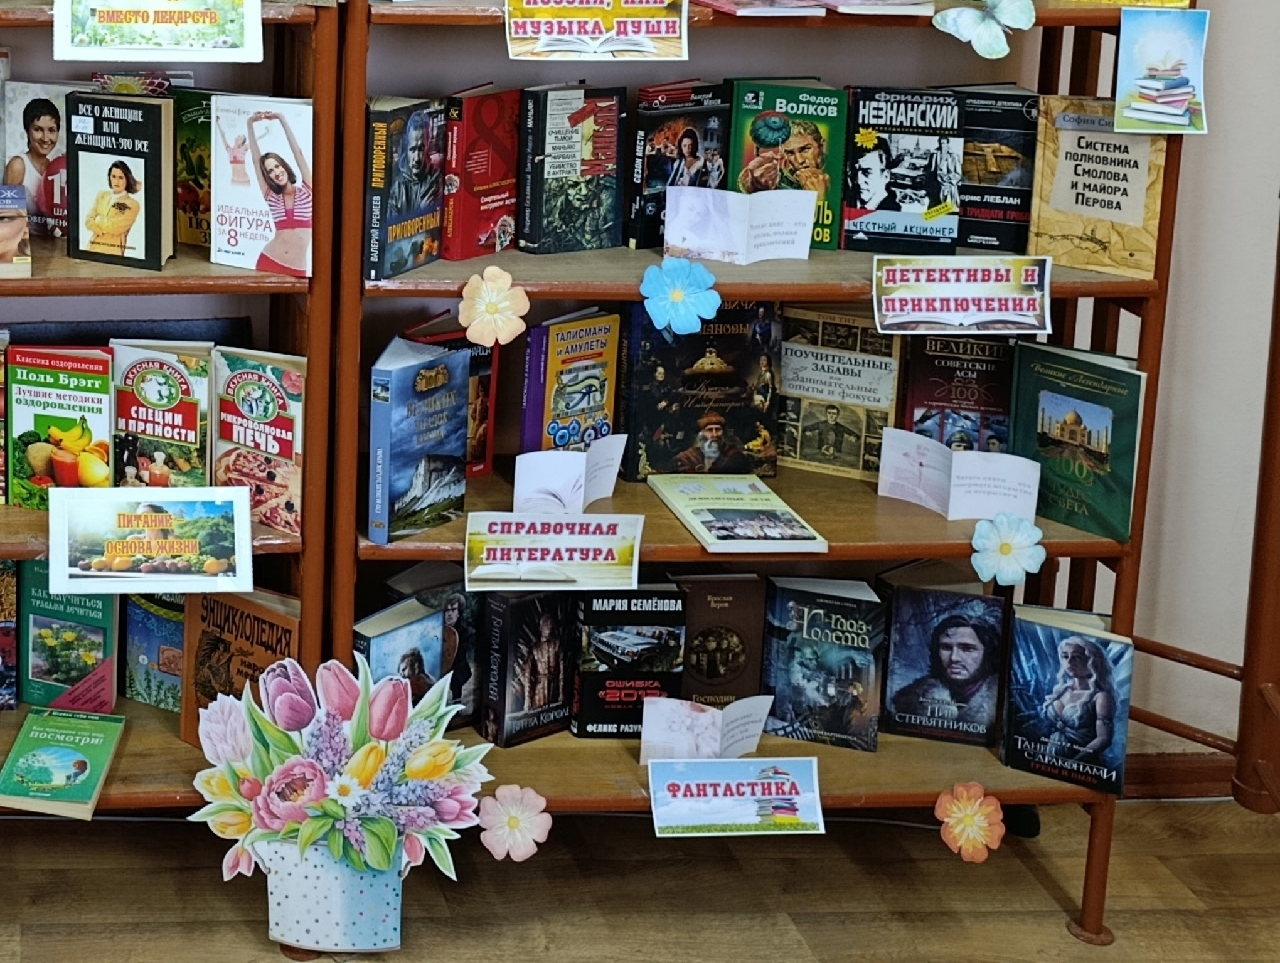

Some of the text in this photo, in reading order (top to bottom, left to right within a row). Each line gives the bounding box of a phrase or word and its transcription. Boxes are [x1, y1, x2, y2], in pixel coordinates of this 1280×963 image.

[97, 10, 218, 26] ВМЕСТО ЛЕКАРСТВ
[511, 19, 679, 38] МУЗЫКА ДУШИ
[798, 92, 839, 105] Федор
[775, 98, 838, 117] Волков
[858, 100, 959, 129] НЕЗНАНСКИЙ
[102, 121, 120, 134] ИЛИ
[1062, 114, 1093, 125] София
[635, 130, 645, 158] МЕСТИ
[1064, 151, 1140, 170] ПОЛКОВНИКА
[982, 195, 1021, 206] ЛЕБЛАН
[217, 204, 270, 218] ИДЕАЛЬНАЯ
[216, 216, 272, 233] ФИГУРА
[370, 195, 381, 264] ВАЛЕРИЙ ЕРЕМЕЕВ
[851, 220, 955, 237] ЧЕСТНЫЙ АКЦИОНЕР
[227, 228, 270, 248] 8 НЕДЕЛЬ
[884, 267, 1038, 284] ДЕТЕКТИВЫ И
[884, 297, 1038, 313] ПРИКЛЮЧЕНИЯ
[555, 323, 612, 343] ТАЛИСМАНЫ
[564, 338, 608, 355] АМУЛЕТЫ
[925, 339, 1009, 357] ВЕЛИКИЕ
[15, 354, 104, 372] Классика оздоровления
[784, 347, 894, 371] ПОУЧИТЕЛЬНЫЕ
[934, 359, 998, 372] СОВЕТСКИЕ
[16, 368, 102, 389] Поль Брэгг
[811, 362, 862, 379] ЗАБАВЫ
[953, 369, 977, 379] АСЫ
[788, 382, 826, 395] опыты
[791, 371, 879, 395] Занимательные
[14, 387, 104, 405] Лучшие методики
[950, 387, 978, 401] 100
[15, 397, 103, 415] оздоровления
[130, 405, 183, 426] СПЕЦИИ
[128, 419, 196, 444] ПРЯНОСТИ
[231, 424, 280, 454] ПЕЧЬ
[117, 513, 173, 530] ПИТАНИЕ
[487, 522, 619, 536] СПРАВОЧНАЯ
[106, 539, 199, 556] ОСНОВА ЖИЗНИ
[485, 547, 616, 562] ЛИТЕРАТУРА
[592, 596, 683, 613] МАРИЯ СЕМЁНОВА
[200, 595, 293, 656] ЭНЦИКЛОПЕДИЯ
[605, 680, 661, 688] ОШИБКА
[894, 712, 987, 734] СТЕРВЯТНИКОВ
[666, 780, 800, 798] ФАНТАСТИКА
